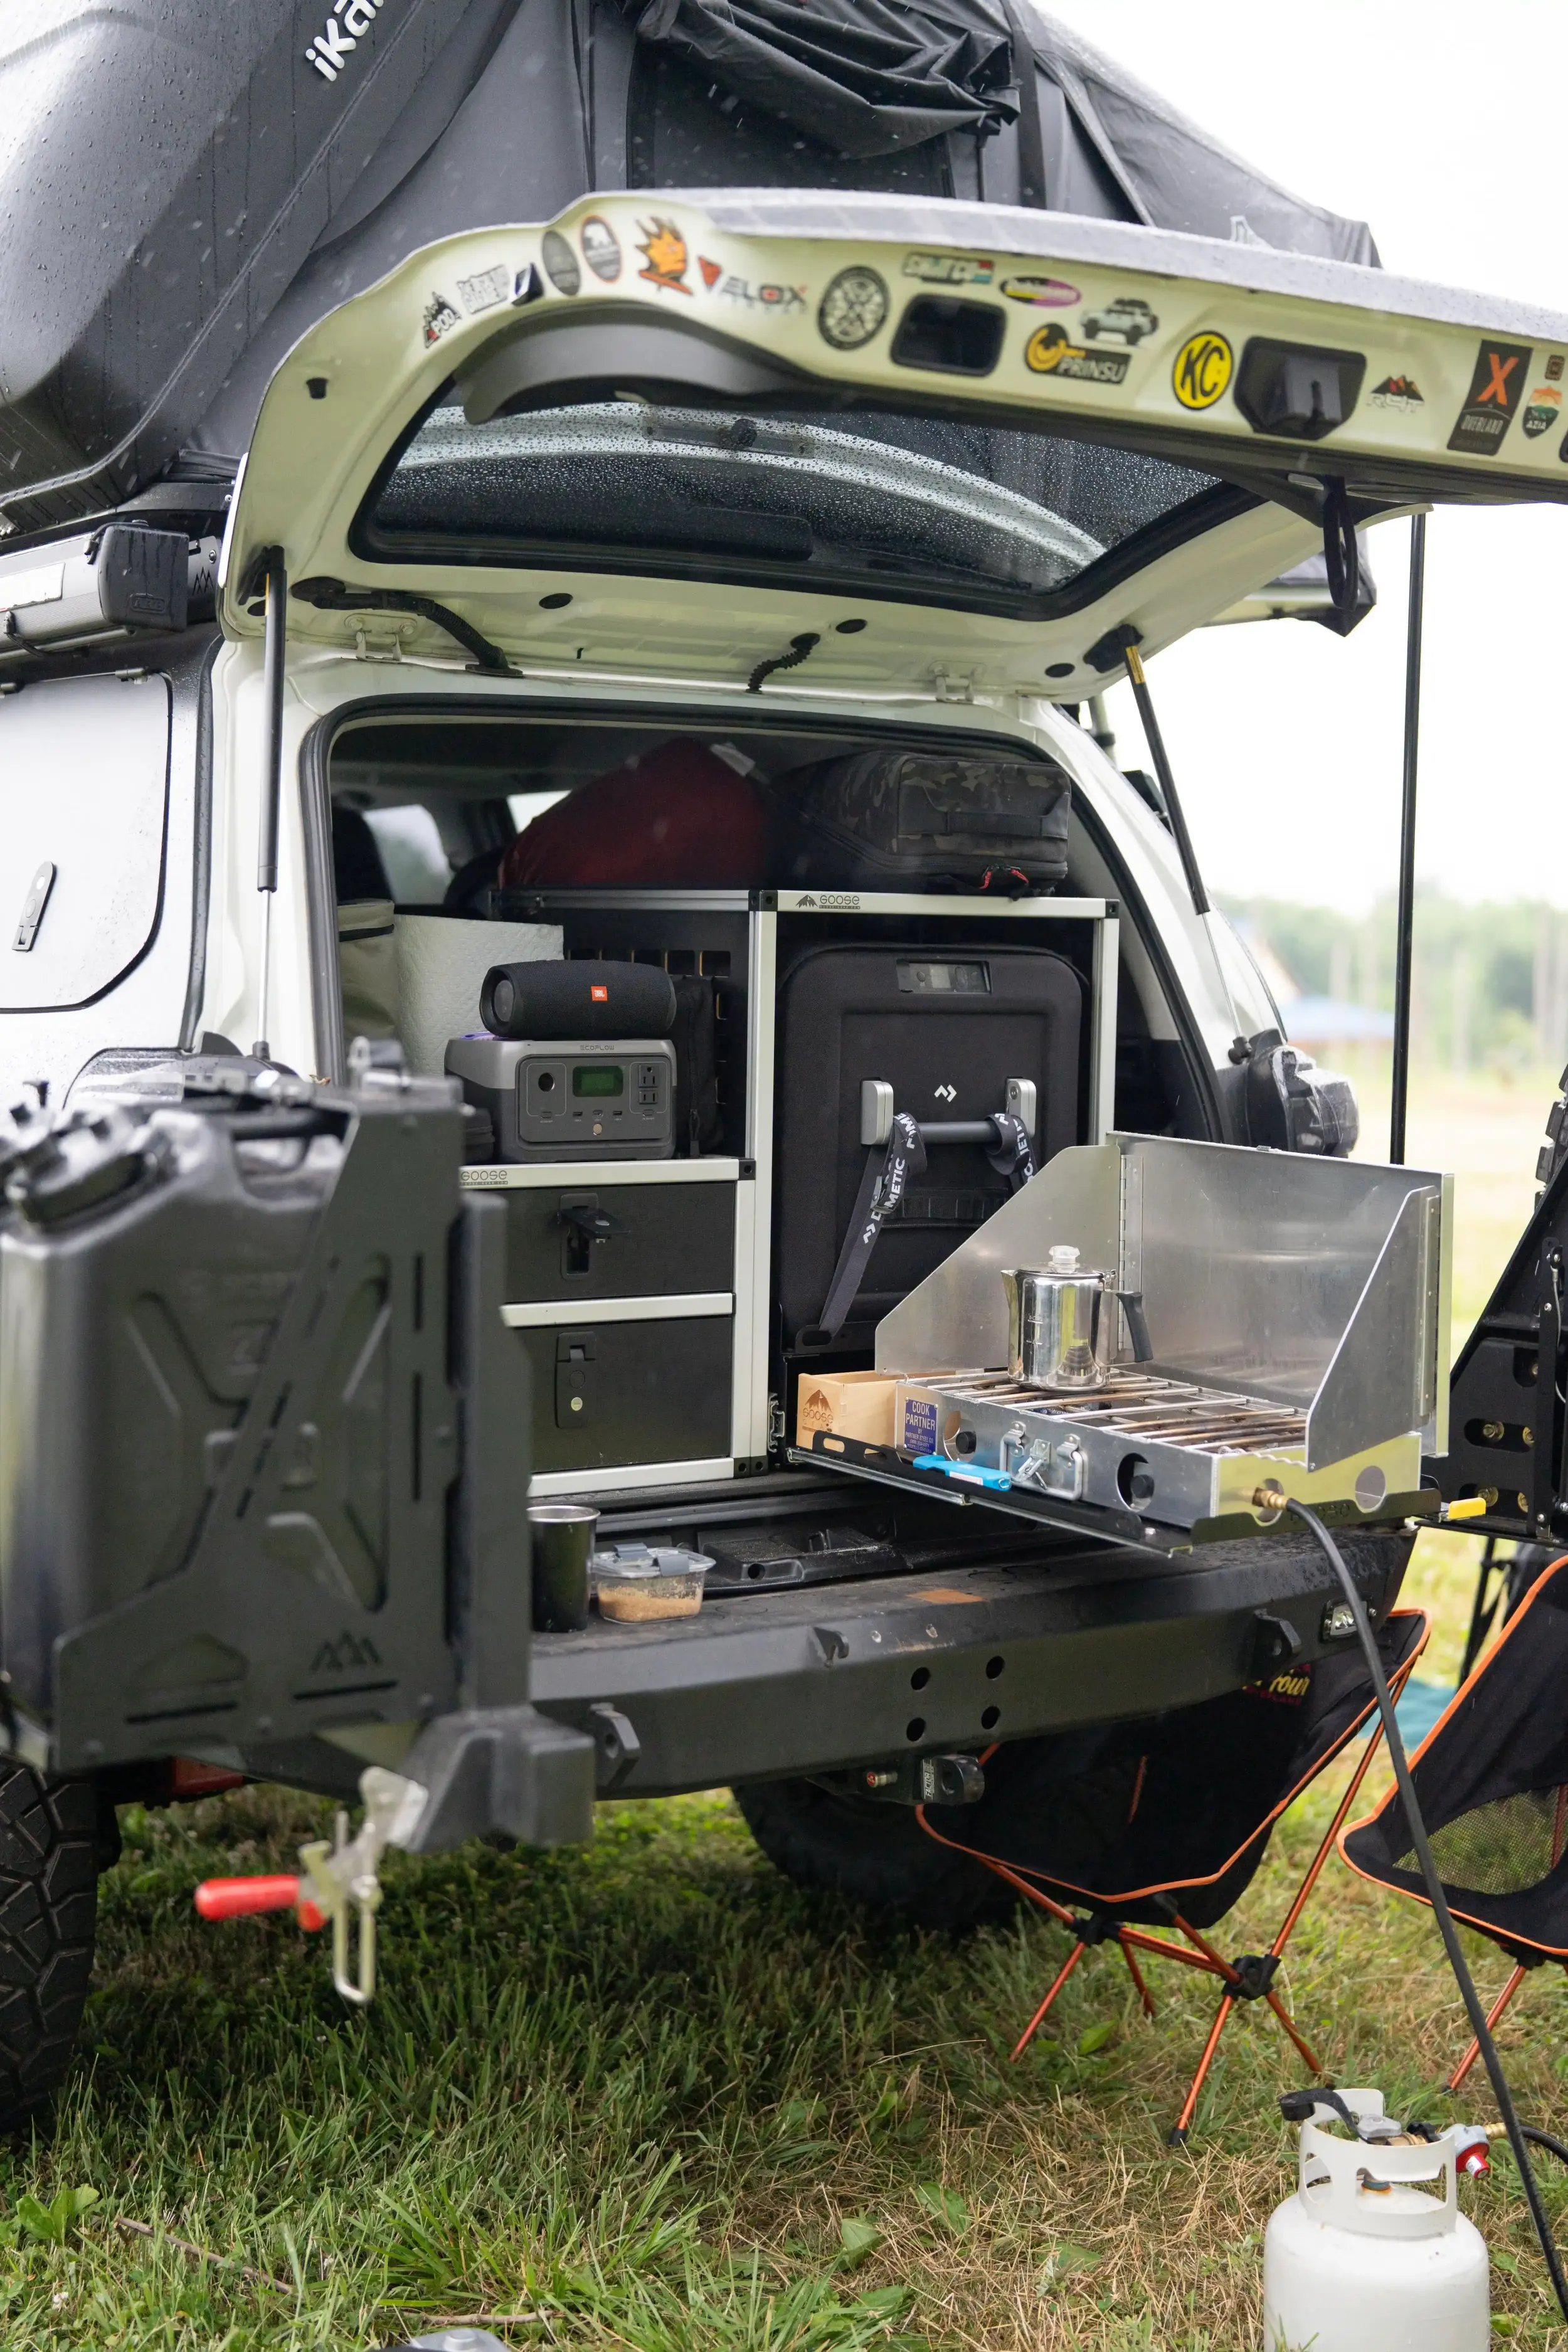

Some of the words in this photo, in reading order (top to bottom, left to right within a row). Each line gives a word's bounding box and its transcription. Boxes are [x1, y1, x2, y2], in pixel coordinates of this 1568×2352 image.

[305, 0, 384, 82] ika
[1056, 356, 1128, 382] PRINSU
[1180, 340, 1224, 400] KC
[1477, 353, 1519, 406] X
[1460, 415, 1504, 435] OVERLAND
[912, 1401, 930, 1416] COOK
[905, 1412, 936, 1431] PARTNER
[905, 1431, 919, 1439] PARTNER
